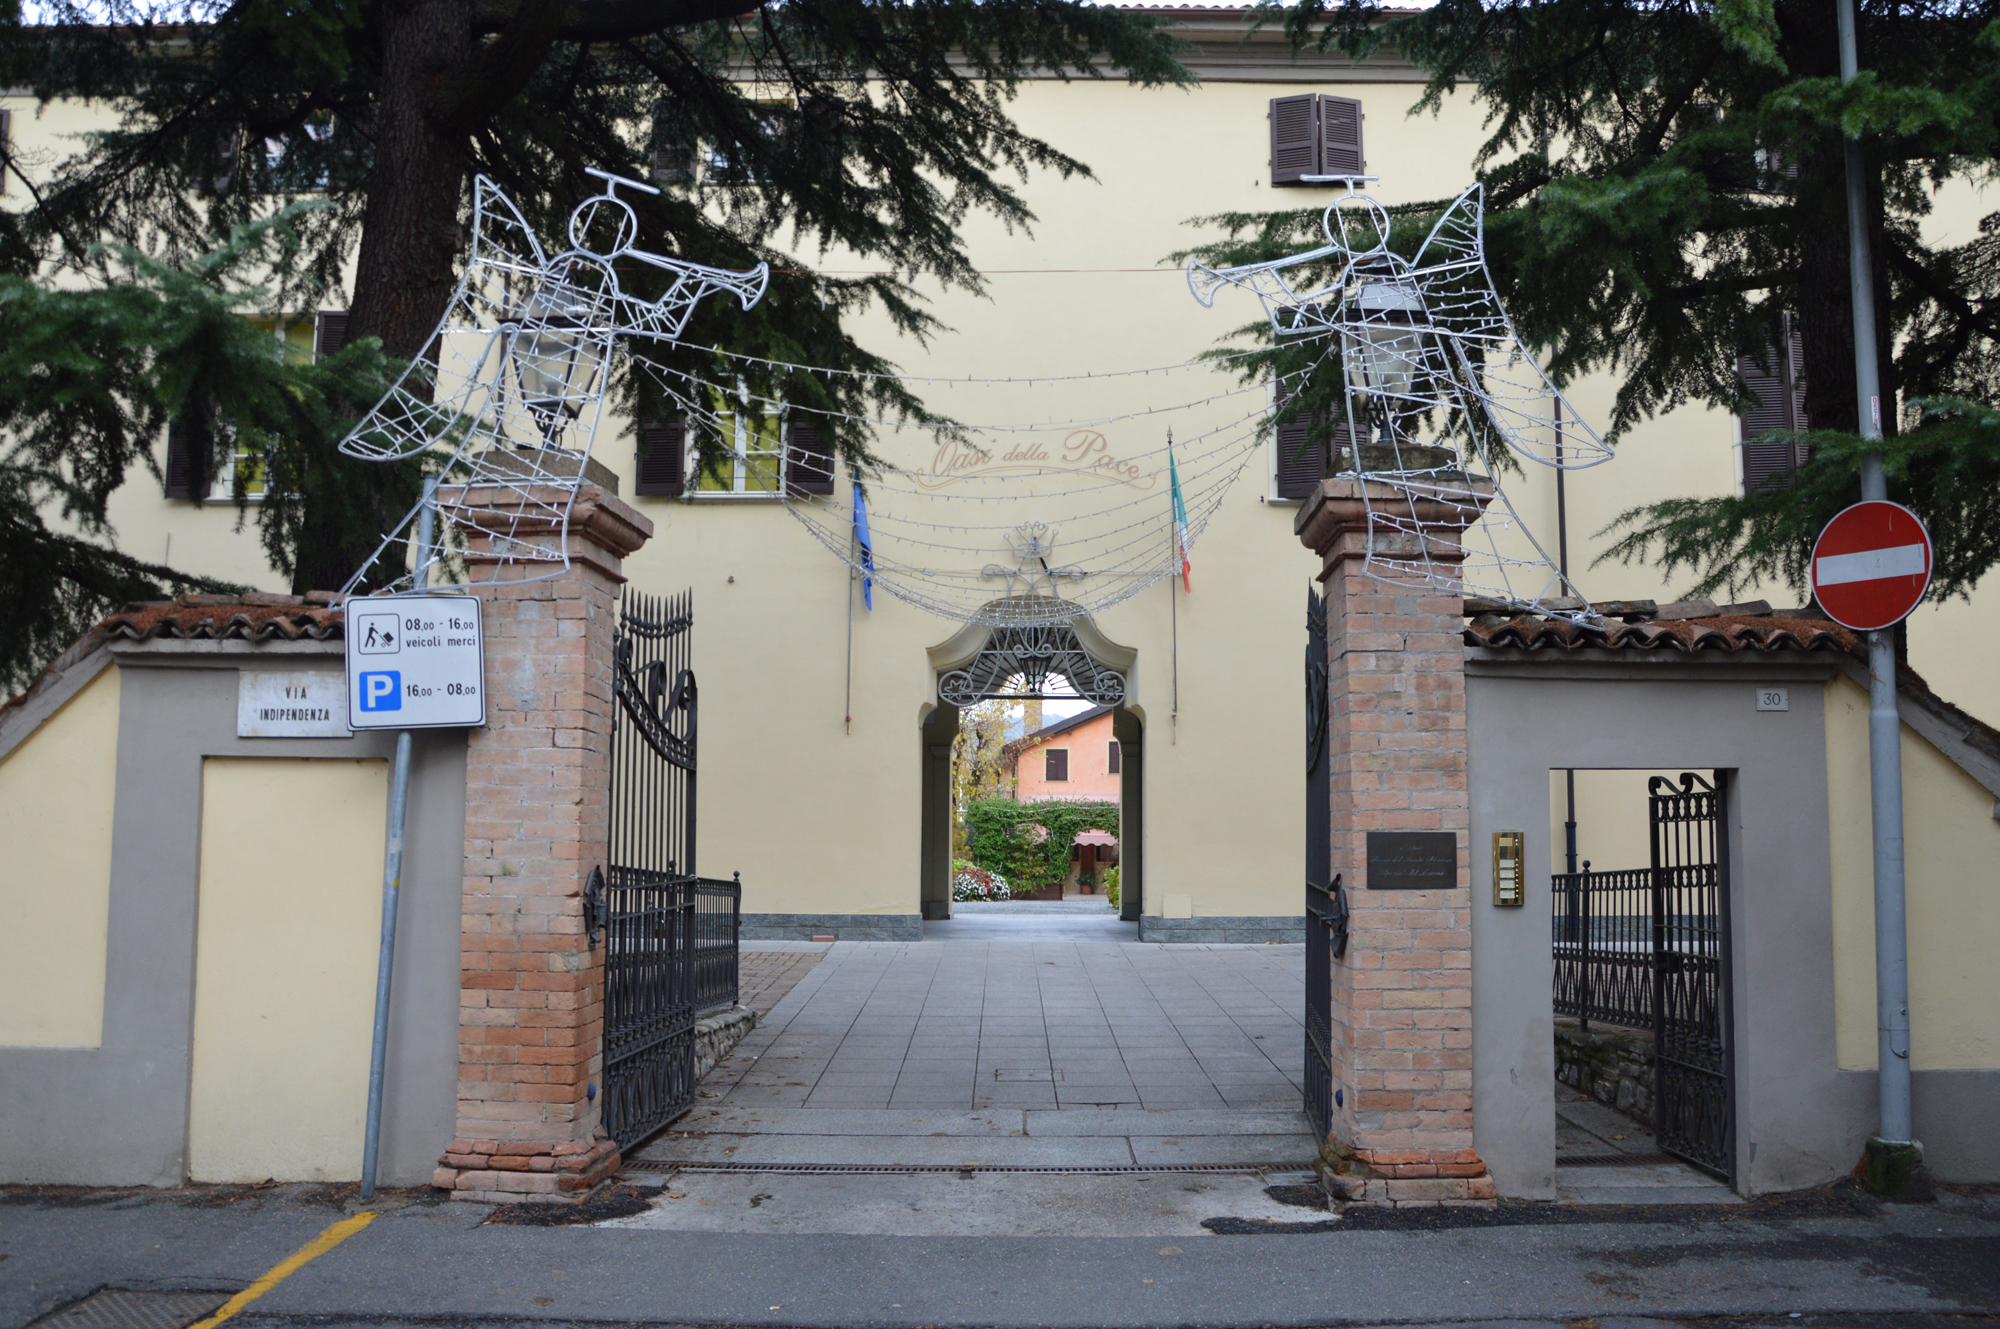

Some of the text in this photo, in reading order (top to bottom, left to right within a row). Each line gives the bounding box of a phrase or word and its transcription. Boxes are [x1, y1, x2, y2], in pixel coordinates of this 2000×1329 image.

[932, 429, 1140, 478] Oasi della Pace
[406, 635, 476, 648] veicoli merci
[285, 686, 307, 700] VIA
[366, 674, 394, 709] P
[1763, 692, 1781, 706] 30
[260, 708, 330, 721] INDIPENDENZA
